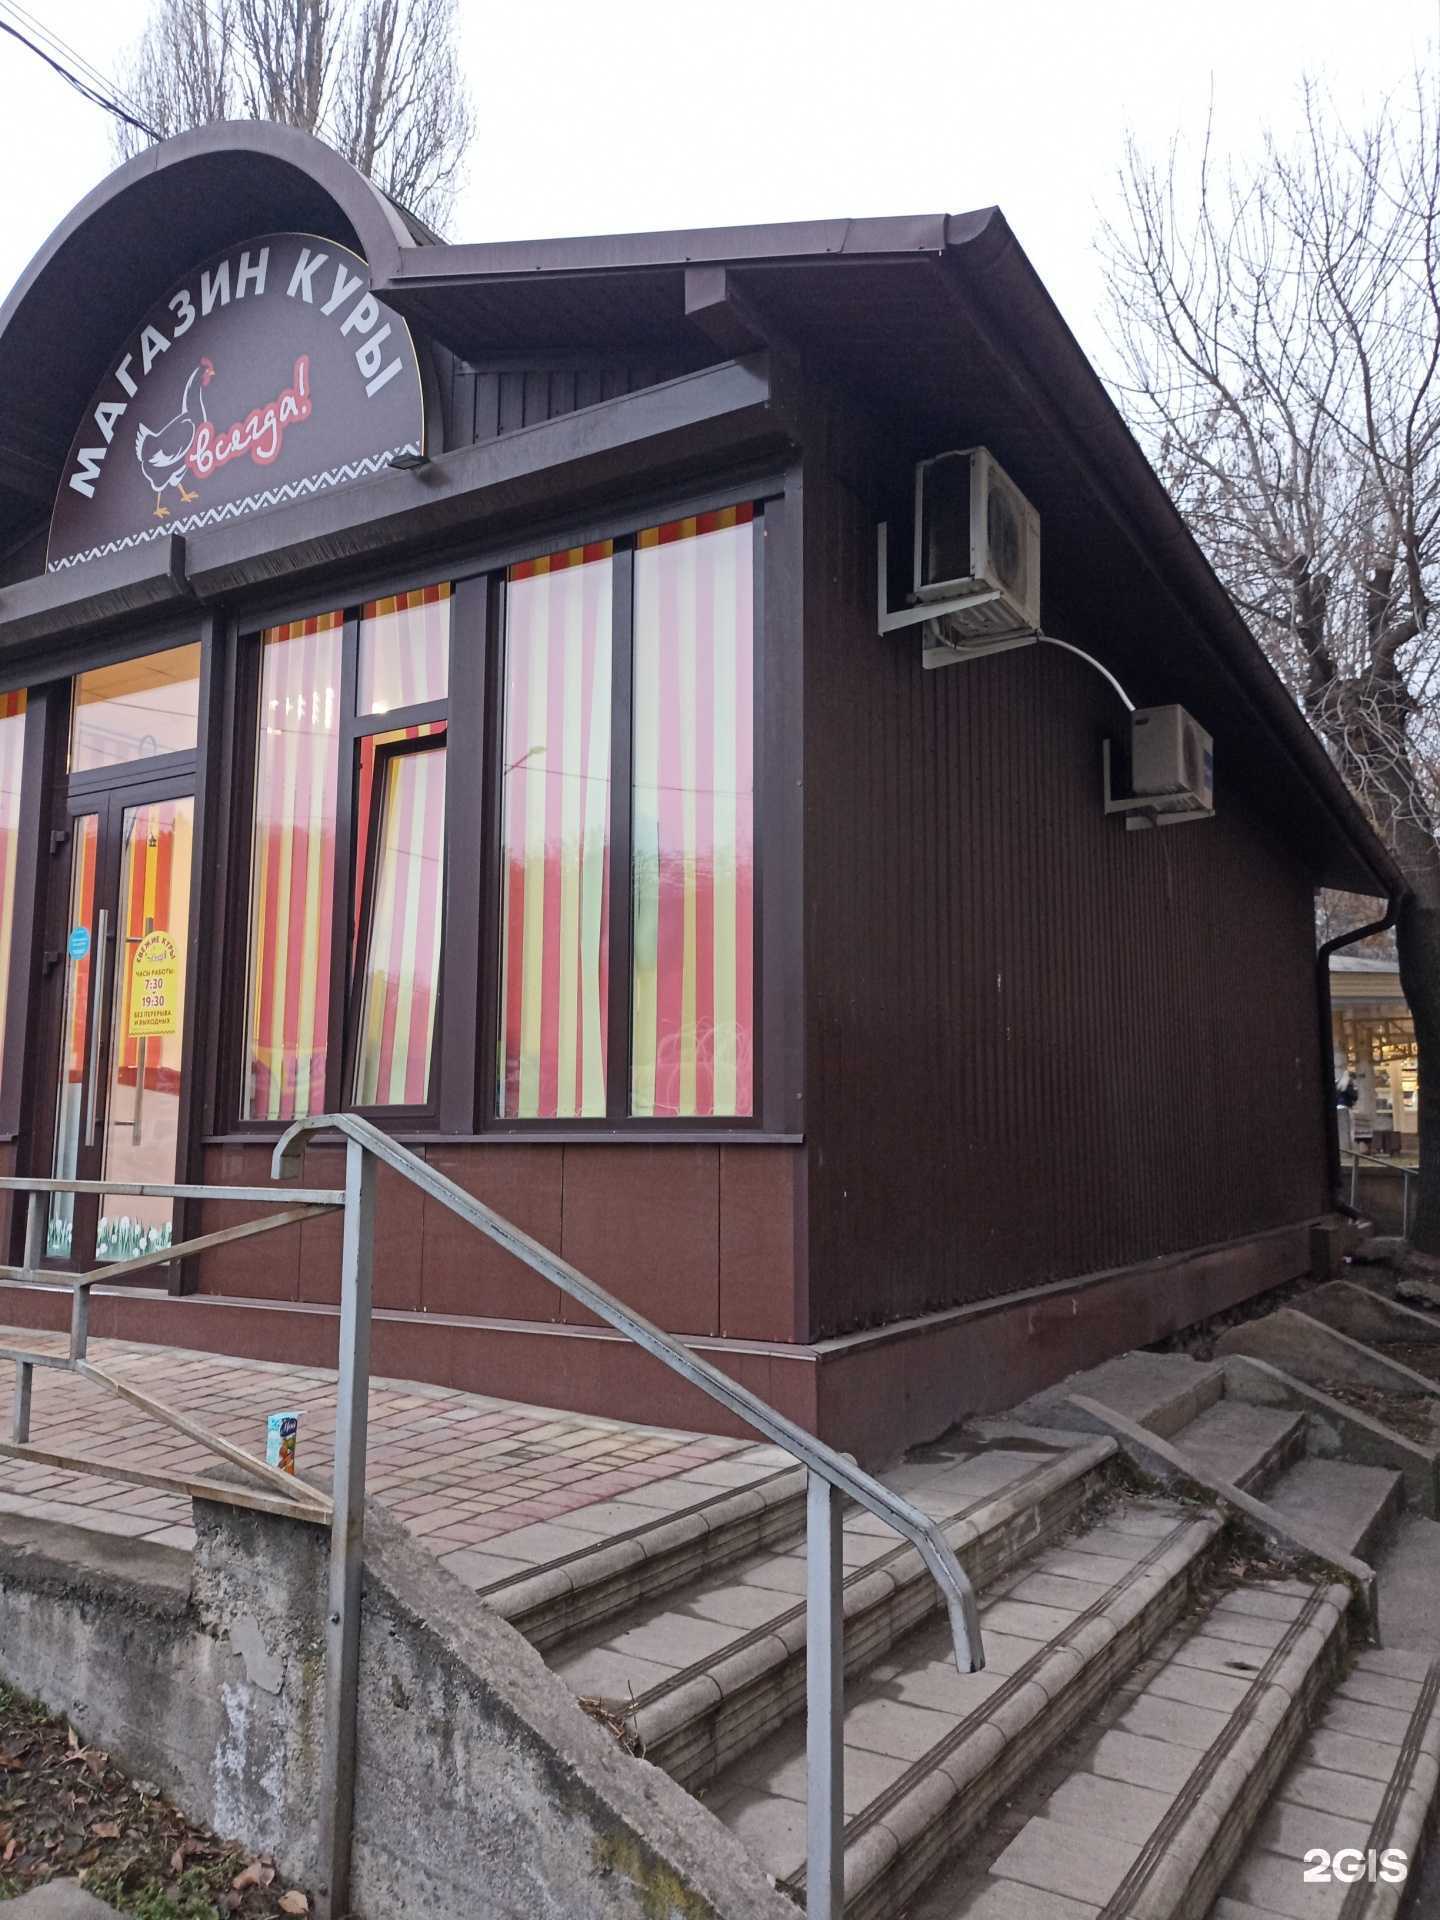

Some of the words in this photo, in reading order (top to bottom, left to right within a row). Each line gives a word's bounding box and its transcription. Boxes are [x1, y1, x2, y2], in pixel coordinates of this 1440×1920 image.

[69, 247, 271, 499] МАГАЗИН
[287, 248, 403, 398] КУРЫ
[189, 362, 307, 474] всегда!
[142, 995, 165, 1007] 19:30
[144, 978, 163, 990] 7:30
